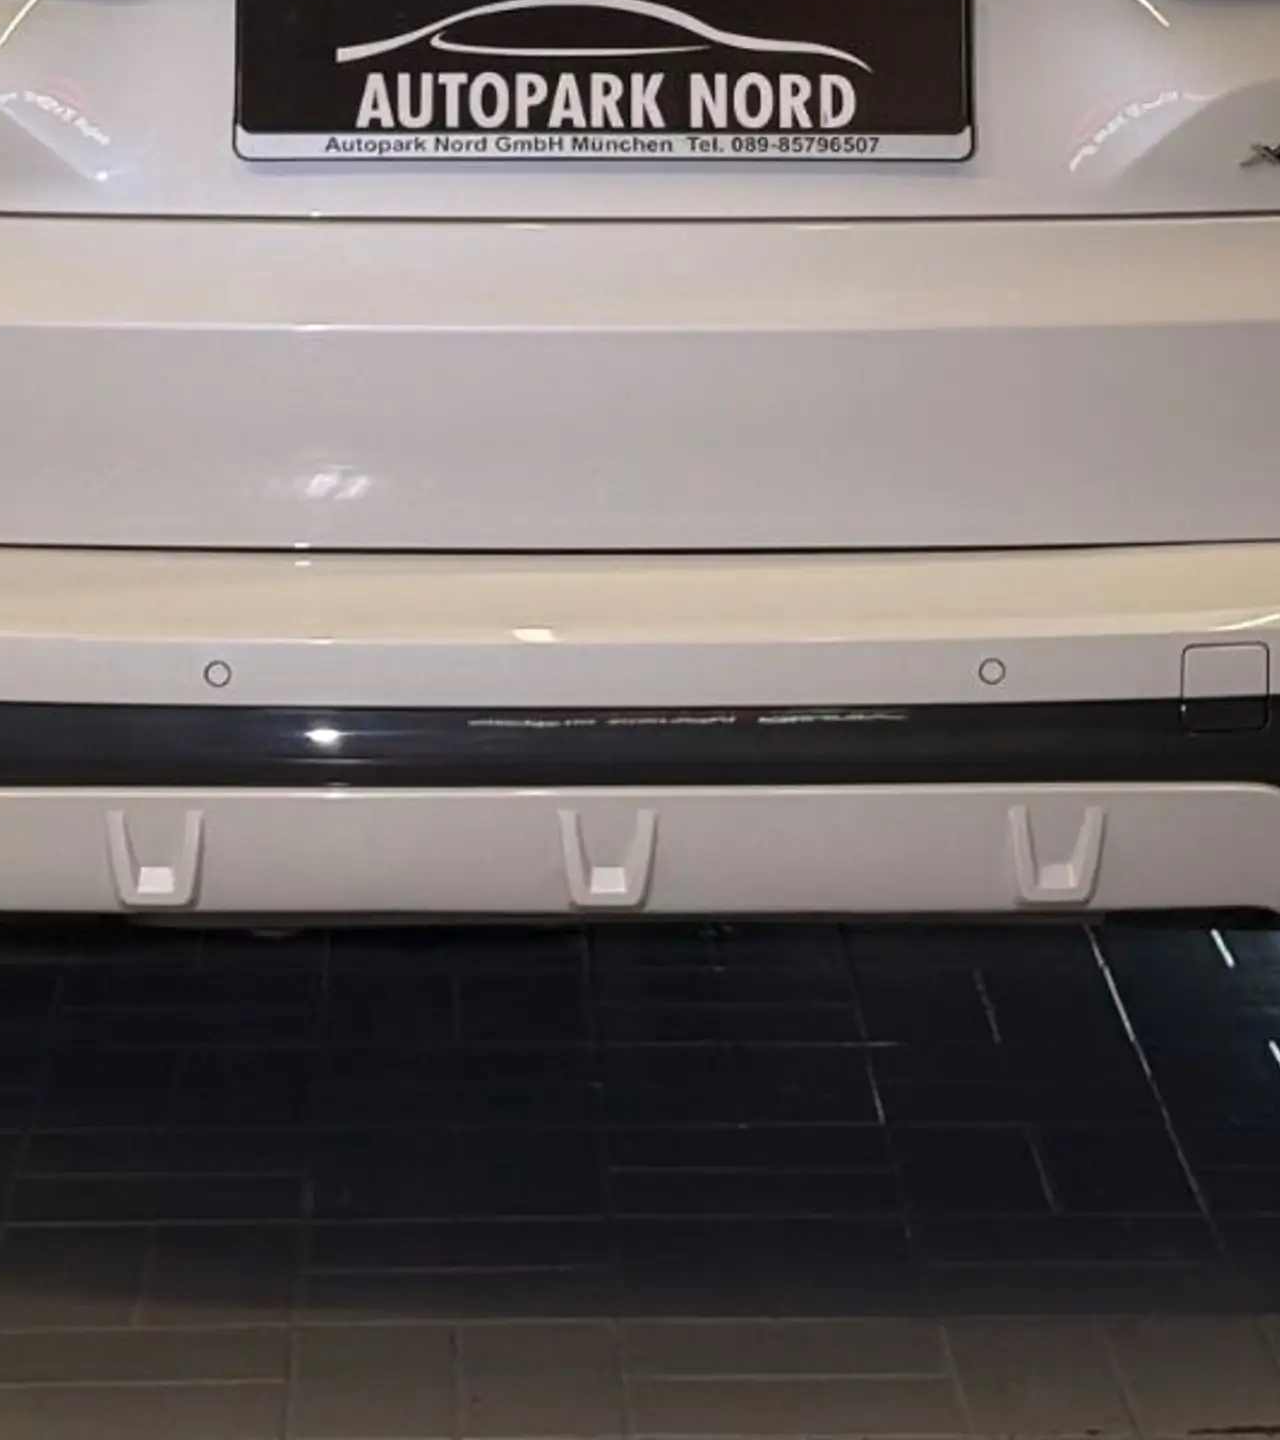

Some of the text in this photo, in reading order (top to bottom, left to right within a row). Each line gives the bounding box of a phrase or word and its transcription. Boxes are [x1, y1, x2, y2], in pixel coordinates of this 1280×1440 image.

[356, 71, 856, 129] AUTOPARK NORD
[325, 136, 880, 157] Autopark Nord GmbH München Tel. 089-85796507
